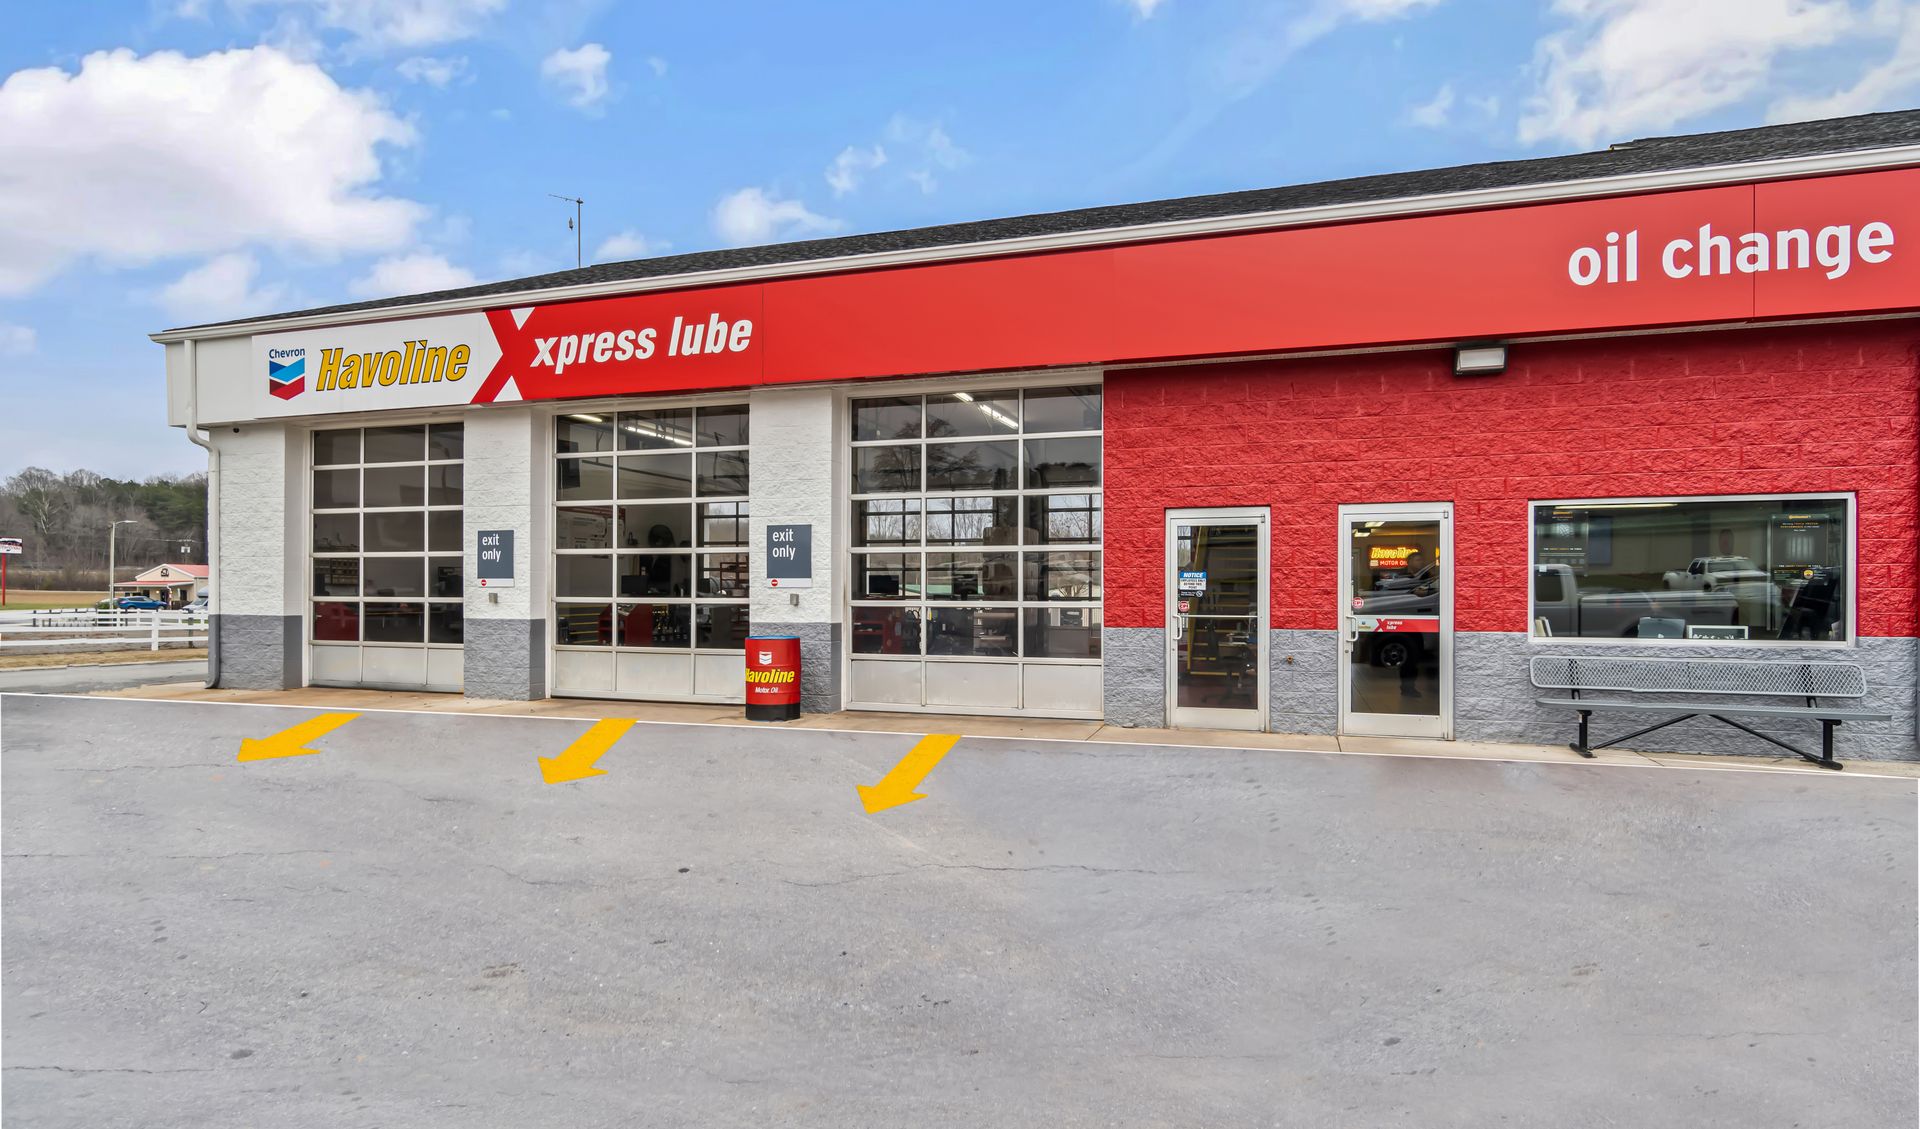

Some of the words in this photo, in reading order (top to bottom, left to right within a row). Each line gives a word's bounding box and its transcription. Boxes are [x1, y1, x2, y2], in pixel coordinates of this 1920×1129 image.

[1568, 229, 1637, 286] oil
[1662, 221, 1894, 281] change
[668, 313, 753, 357] lube
[268, 347, 306, 360] Chevron
[315, 339, 471, 392] Havoline
[482, 533, 500, 546] exit
[772, 528, 794, 542] exit
[482, 548, 502, 563] only
[772, 544, 796, 561] only
